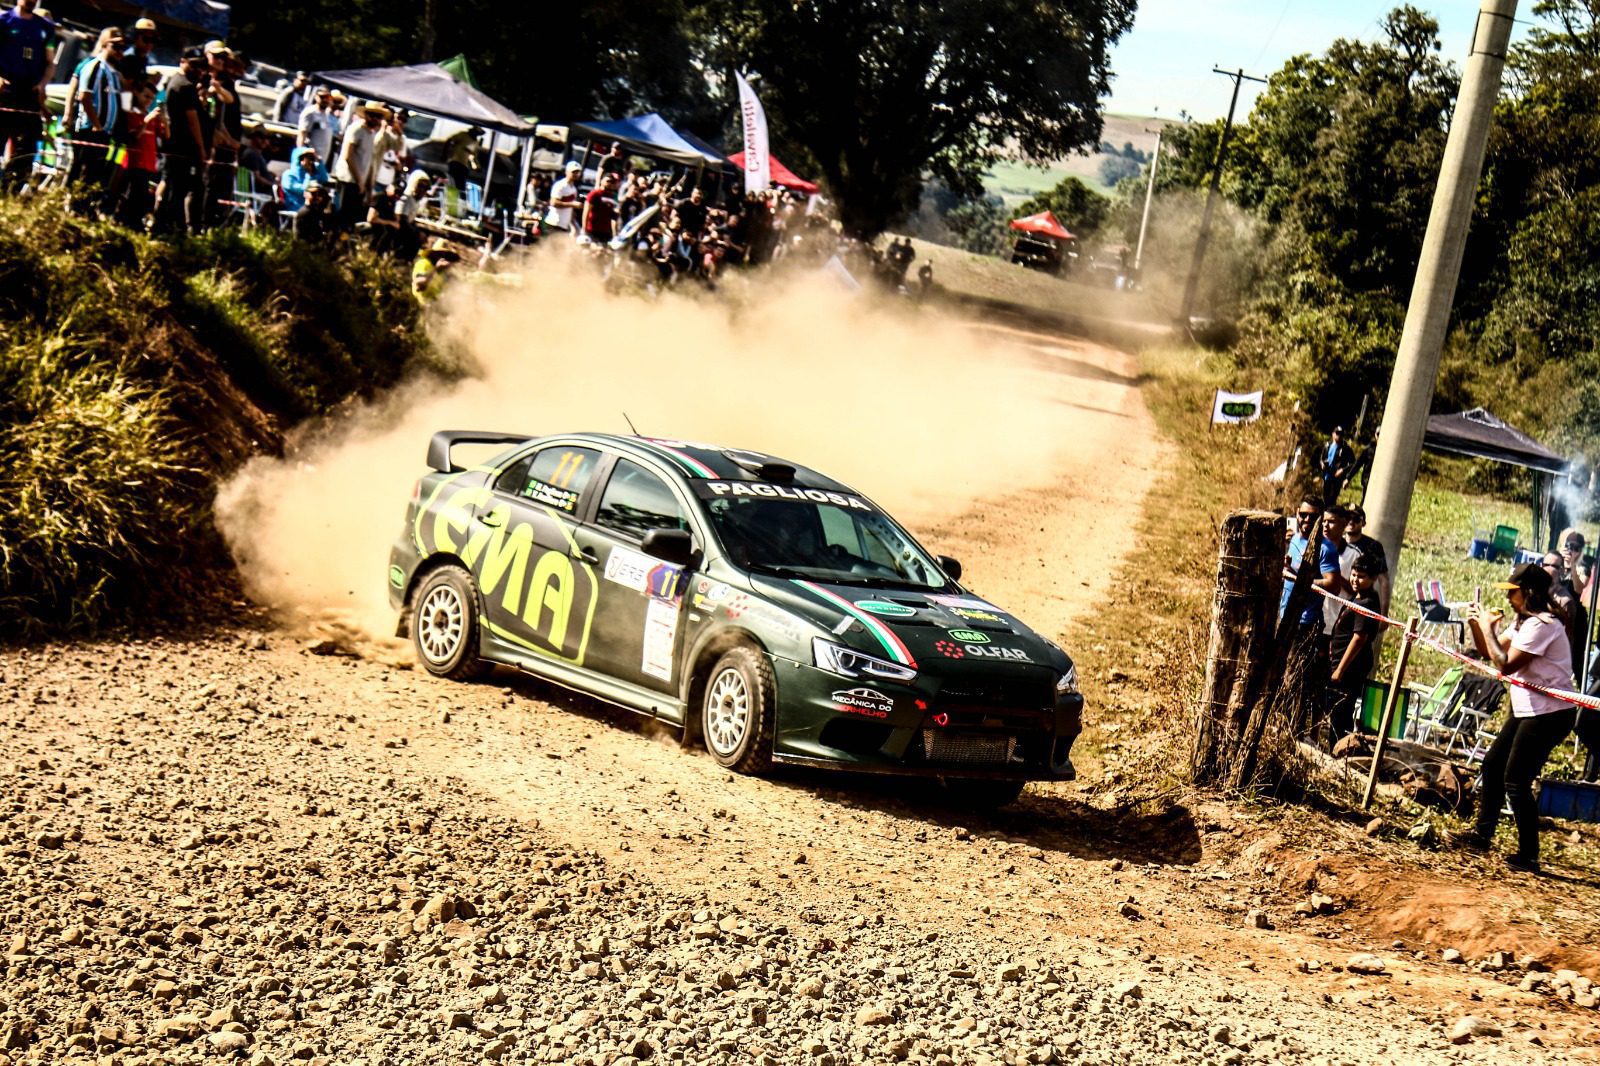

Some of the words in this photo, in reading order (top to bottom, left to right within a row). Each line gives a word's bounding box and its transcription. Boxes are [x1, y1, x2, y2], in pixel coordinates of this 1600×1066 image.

[548, 451, 585, 488] 11
[706, 482, 872, 512] PAGLIOSA
[433, 486, 575, 652] EMA
[660, 570, 681, 600] 11
[958, 631, 987, 642] EMA
[969, 644, 1032, 661] OLFAR
[831, 695, 877, 709] MECÂNICA
[878, 704, 892, 712] DO
[834, 703, 888, 718] RMELHO
